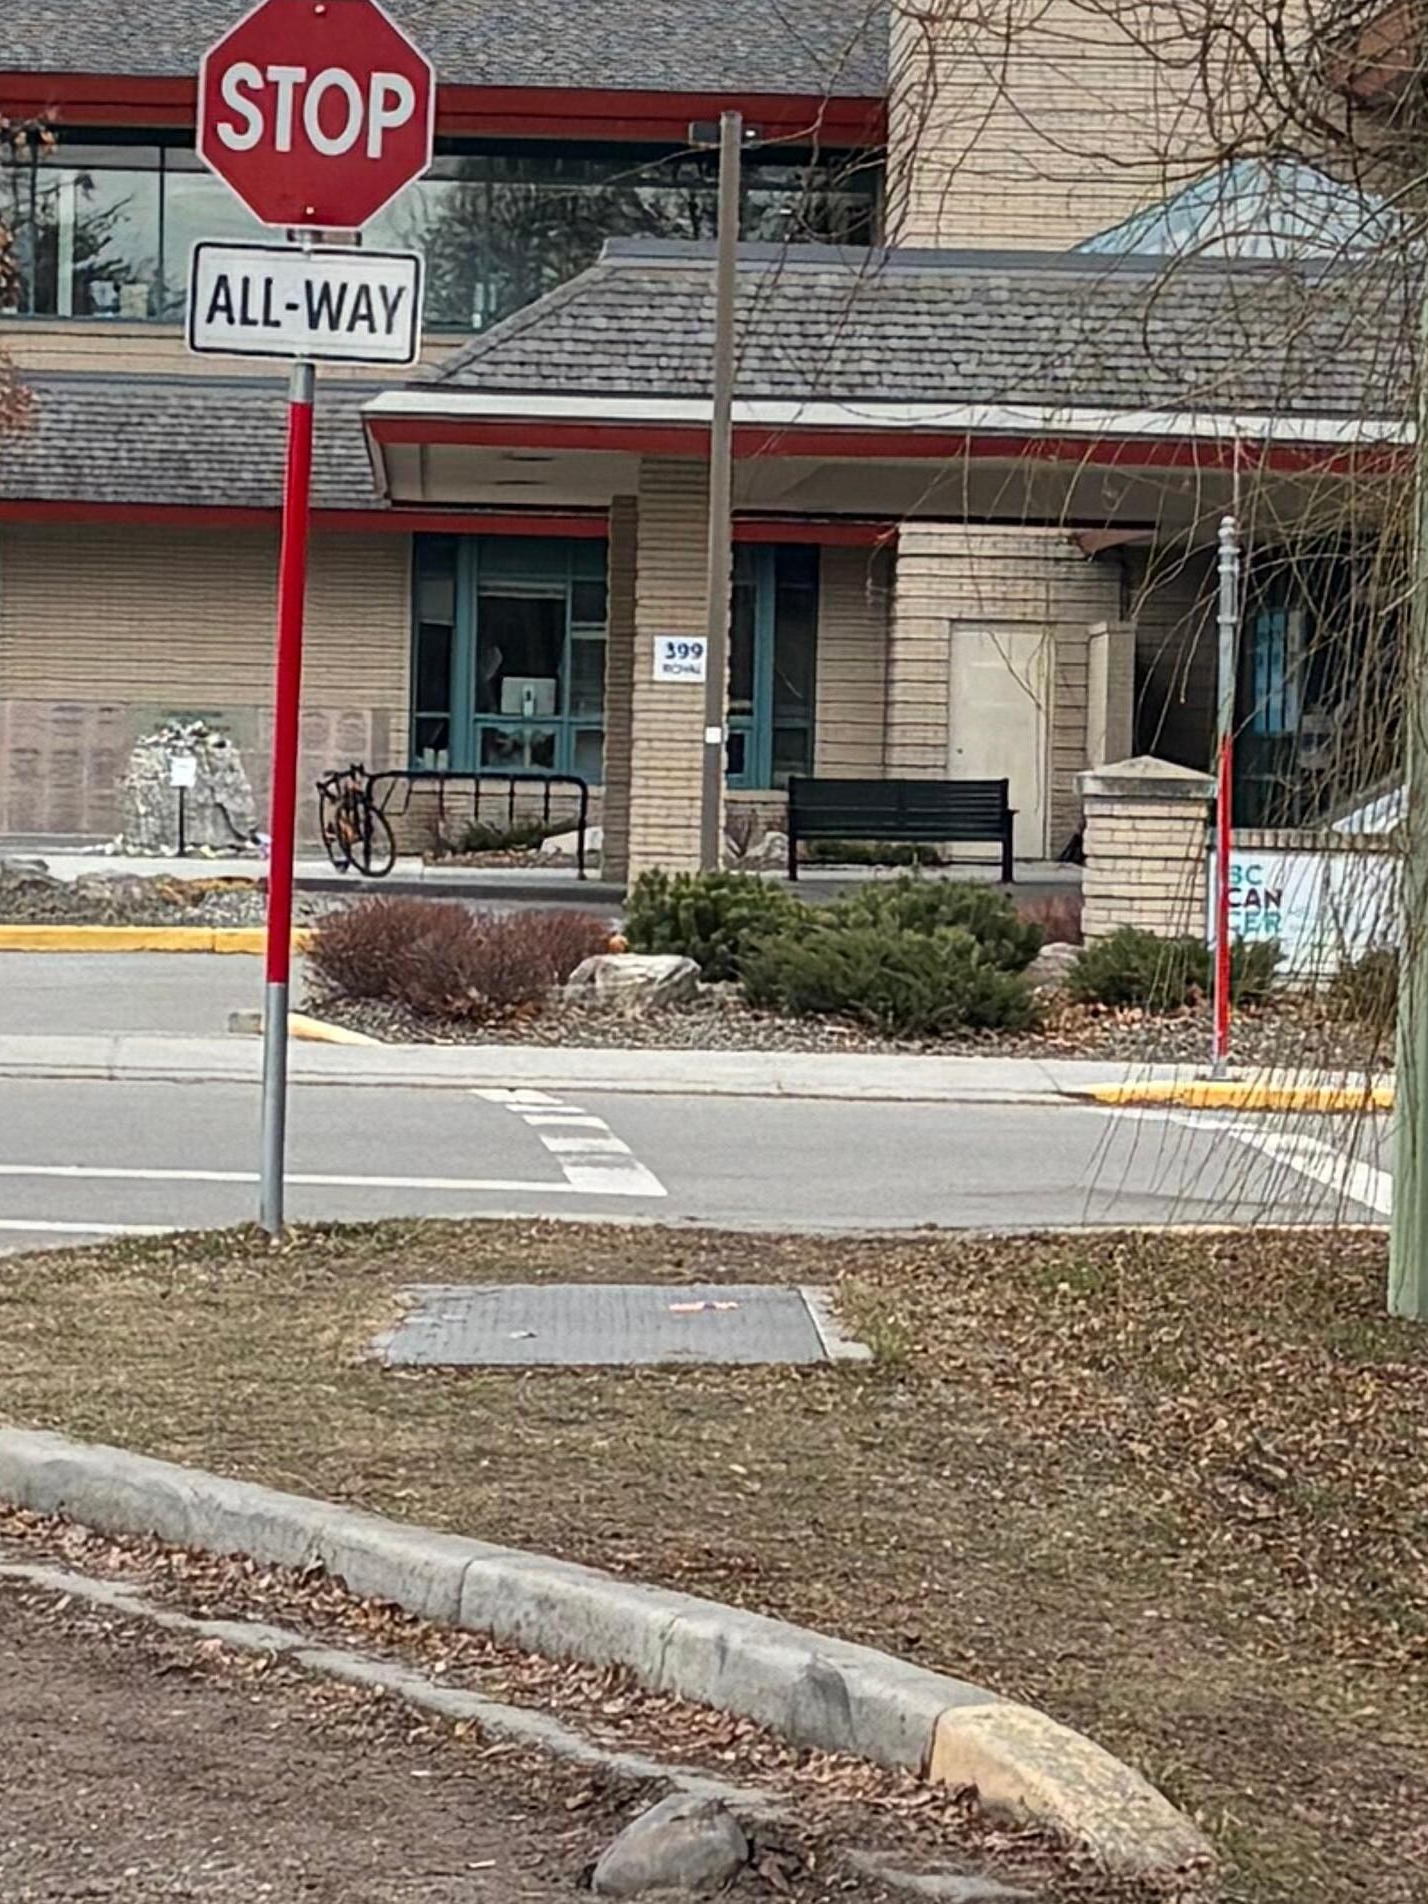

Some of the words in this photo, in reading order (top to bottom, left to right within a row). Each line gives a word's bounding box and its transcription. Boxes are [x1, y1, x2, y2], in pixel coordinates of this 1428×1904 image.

[216, 61, 415, 159] STOP
[205, 273, 407, 336] ALL-WAY
[665, 641, 704, 660] 399
